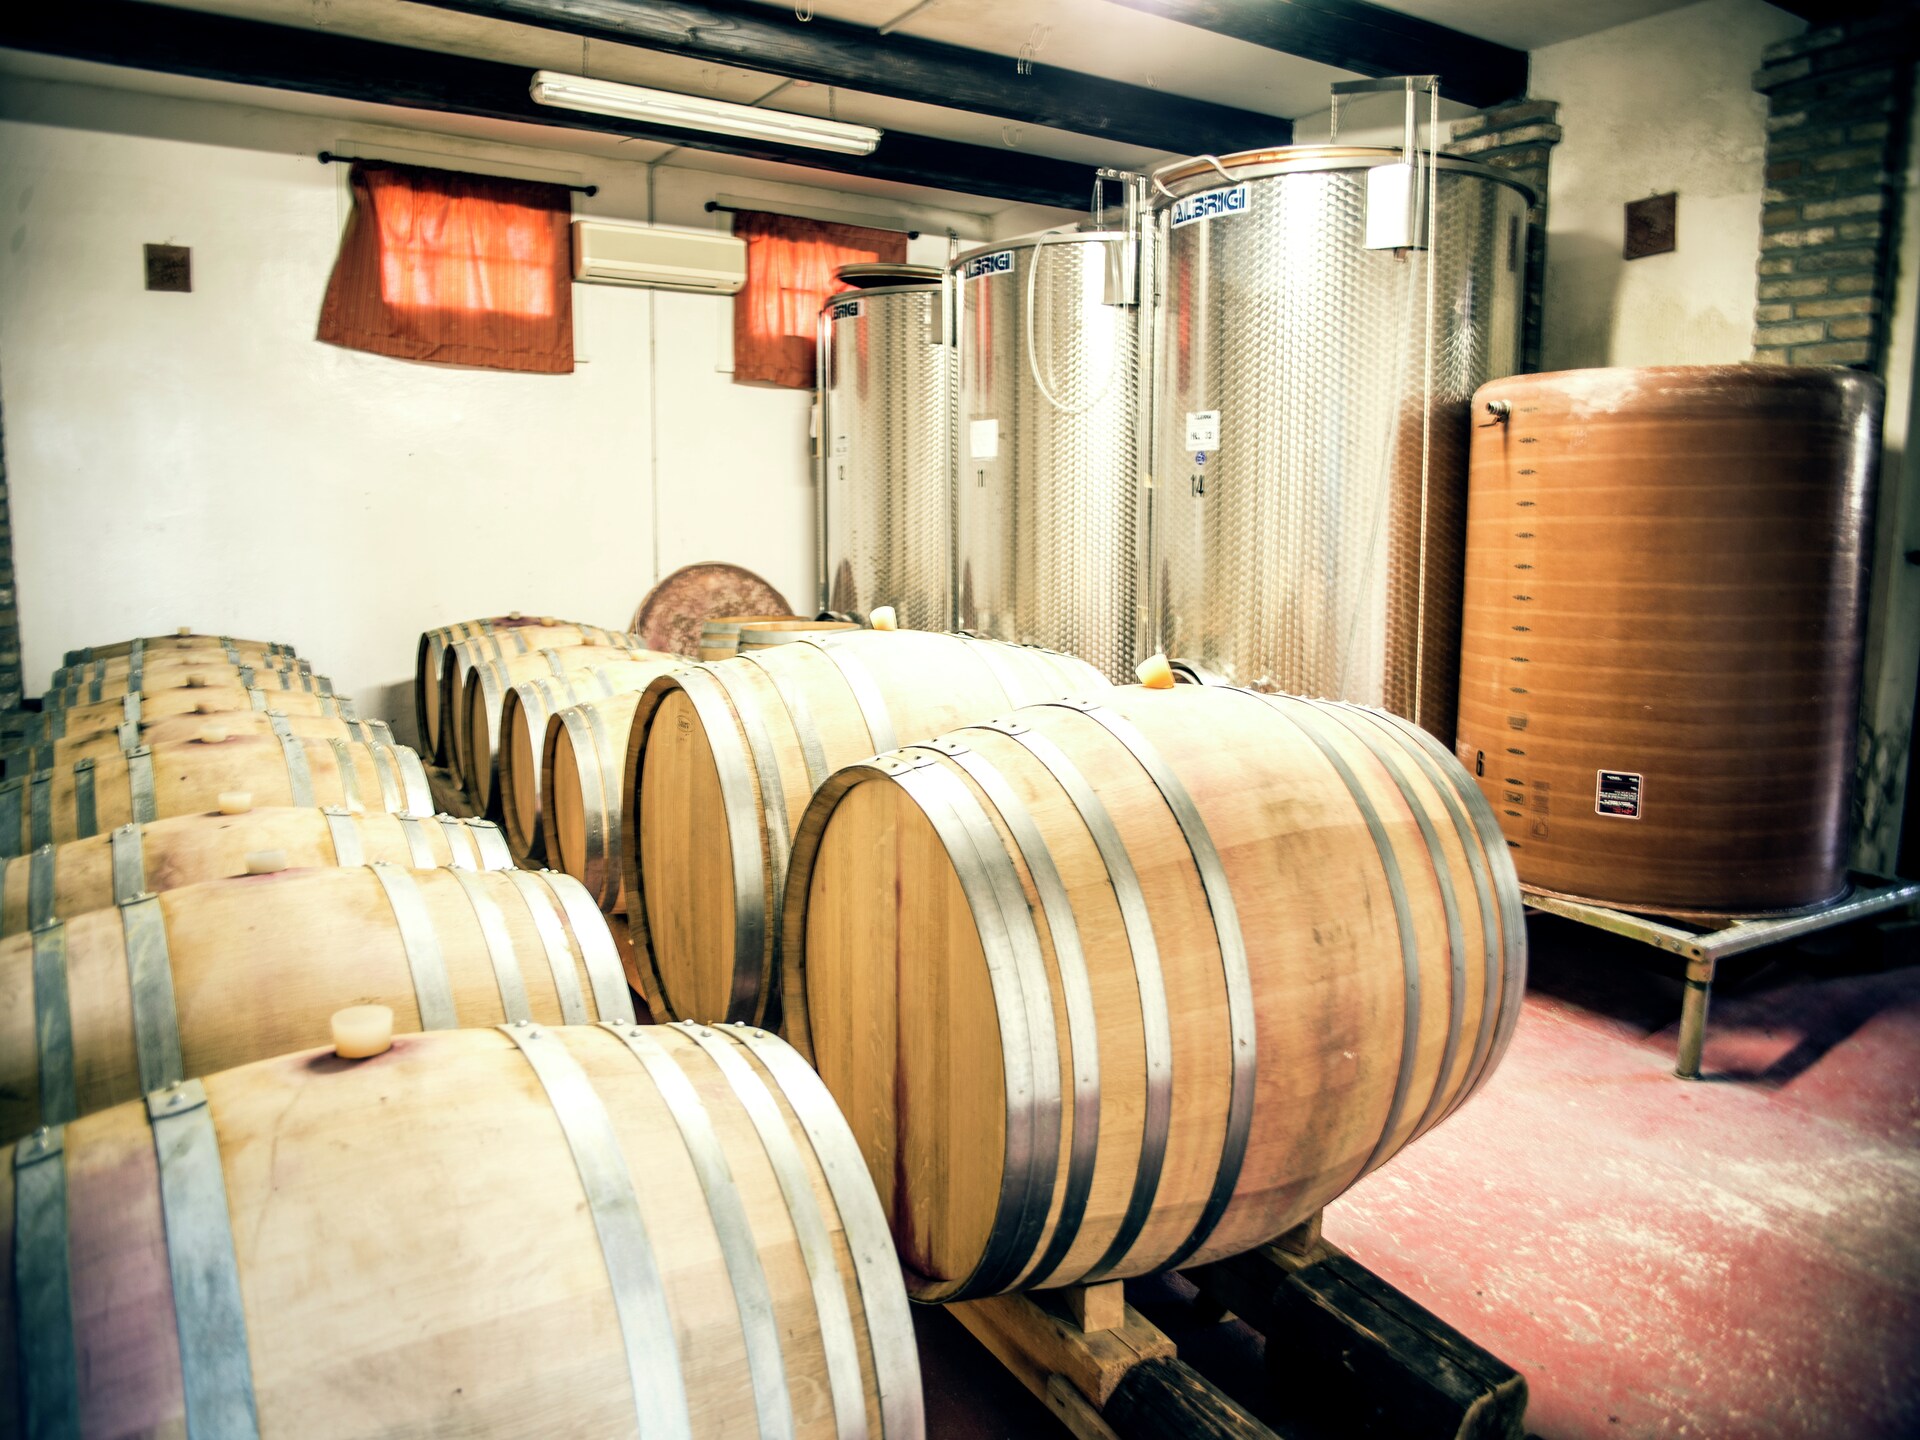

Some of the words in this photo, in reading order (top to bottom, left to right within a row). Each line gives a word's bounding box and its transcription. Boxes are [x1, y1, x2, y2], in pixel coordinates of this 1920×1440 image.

[1172, 188, 1246, 226] ALBRIGI
[1190, 473, 1206, 498] 14
[1475, 749, 1486, 778] 6
